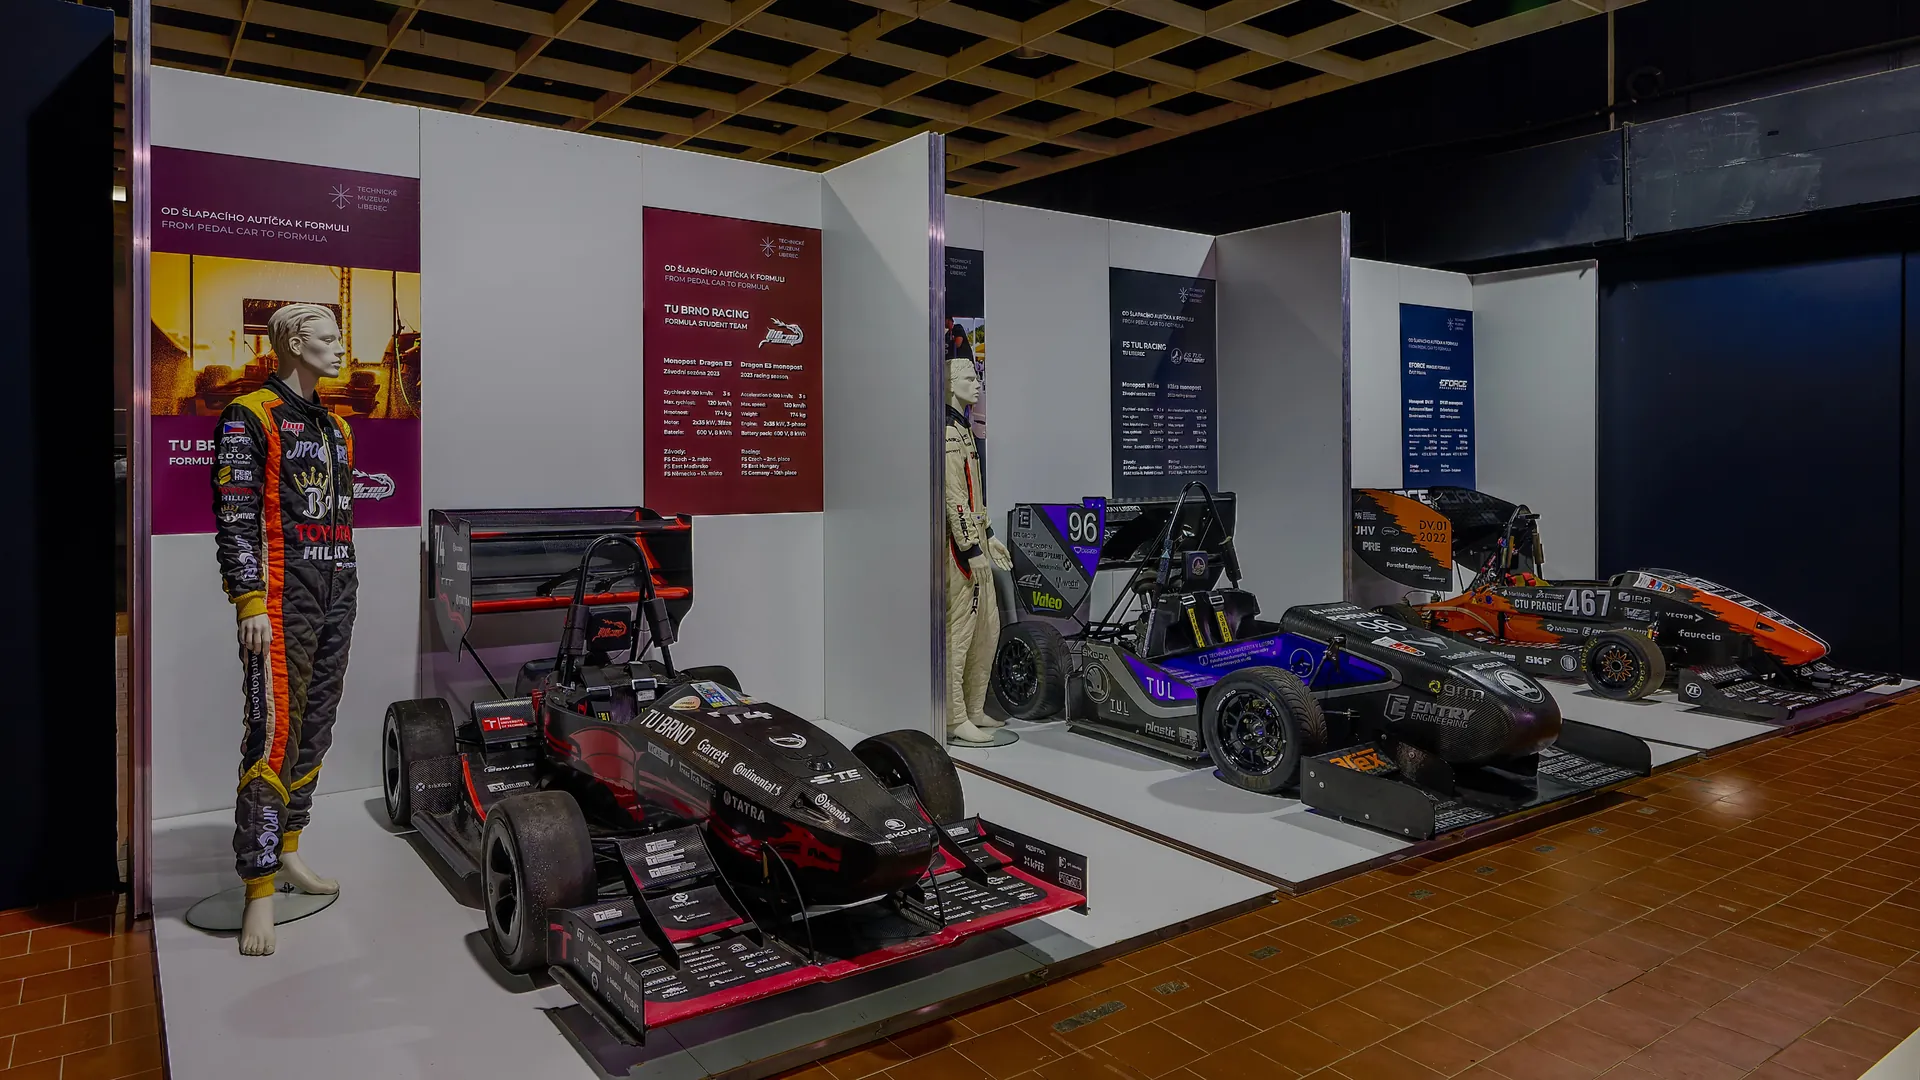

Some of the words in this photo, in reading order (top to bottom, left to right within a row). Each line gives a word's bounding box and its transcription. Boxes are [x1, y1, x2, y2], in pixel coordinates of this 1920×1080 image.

[357, 186, 398, 196] TECHNICKÉ
[358, 194, 390, 204] MUZEUM
[358, 204, 388, 212] LIBEREC
[161, 206, 179, 216] OD
[182, 207, 244, 222] ŠLAPACÍHO
[248, 214, 292, 227] AUTÍČKA
[296, 220, 302, 228] K
[304, 221, 349, 232] FORMULI
[162, 220, 194, 230] FROM
[198, 224, 233, 234] PEDAL
[236, 226, 258, 236] CAR
[261, 229, 275, 238] TO
[278, 230, 328, 242] FORMULA
[677, 265, 717, 276] ŠLAPACÍHO
[719, 270, 748, 279] AUTÍČKA
[756, 274, 785, 282] FORMULI
[665, 275, 685, 283] FROM
[687, 277, 709, 285] PEDAL
[738, 282, 769, 291] FORMULA
[664, 305, 678, 314] TU
[681, 306, 709, 316] BRNO
[712, 308, 749, 319] RACING
[665, 318, 697, 326] FORMULA
[699, 321, 728, 329] STUDENT
[700, 360, 723, 368] Dragon
[754, 372, 770, 380] racing
[169, 440, 192, 451] TU
[196, 440, 216, 451] BR
[169, 457, 215, 466] FORMUL
[1069, 512, 1097, 542] 96
[1356, 526, 1375, 535] JHV
[1419, 520, 1447, 530] DV.01
[295, 524, 351, 542] TOYOTA
[1420, 533, 1446, 543] 2022
[303, 546, 349, 560] HILUX
[1362, 541, 1380, 551] PRE
[1405, 563, 1431, 572] Engineering
[1032, 591, 1062, 609] Valeo
[1514, 599, 1529, 609] CTU
[1531, 601, 1562, 612] PRAGUE
[1564, 590, 1610, 617] 467
[1666, 612, 1693, 620] VECTOR
[1678, 629, 1720, 640] faurecia
[1525, 655, 1552, 665] SKF
[1146, 677, 1175, 700] TUL
[1688, 685, 1701, 695] ZF
[1110, 699, 1129, 716] TUL
[1413, 700, 1476, 720] ENTRY
[640, 709, 665, 728] TU
[655, 716, 696, 745] BRNO
[1411, 713, 1468, 728] ENGINEERING
[1145, 721, 1175, 738] plastic
[697, 738, 729, 764] Garrett
[733, 796, 766, 823] TATRA
[823, 800, 851, 824] brembo
